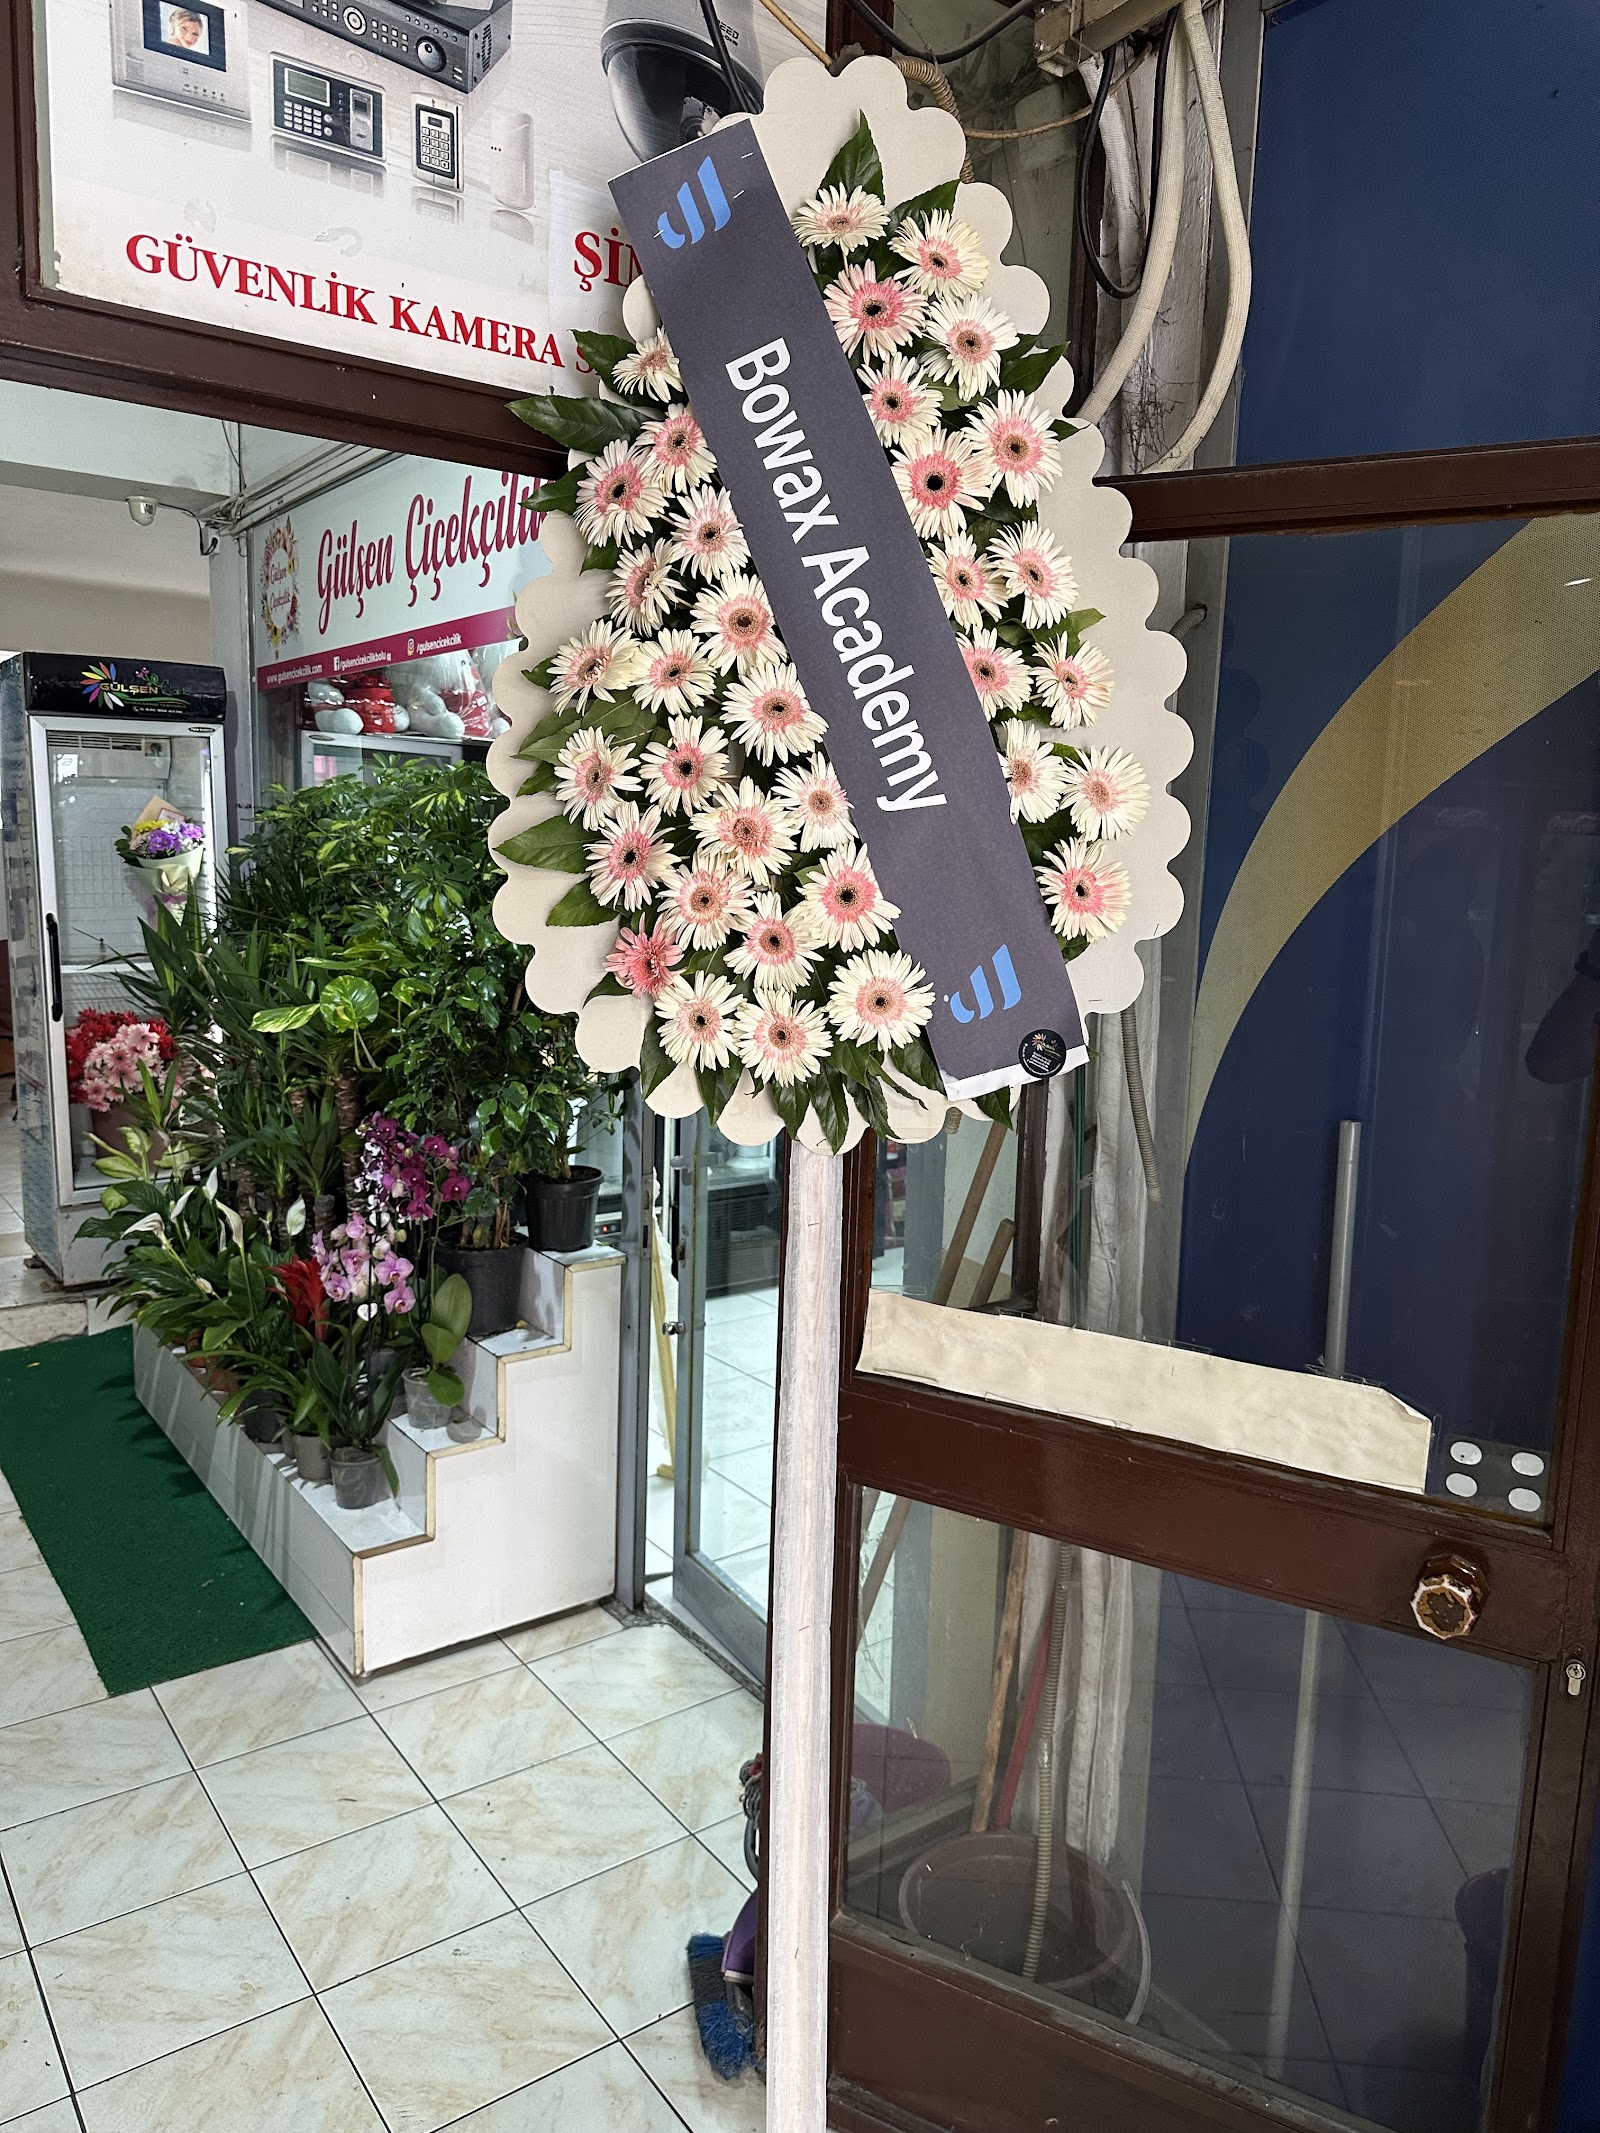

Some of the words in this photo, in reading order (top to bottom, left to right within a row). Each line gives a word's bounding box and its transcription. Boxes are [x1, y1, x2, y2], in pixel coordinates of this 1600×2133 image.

[717, 19, 740, 40] EED
[125, 232, 378, 325] GÜVENLİK
[389, 294, 565, 368] KAMERA
[317, 519, 394, 635] Gülşen
[725, 336, 840, 545] Bowax
[801, 545, 948, 812] Academy
[100, 681, 158, 695] GÜLŞEN
